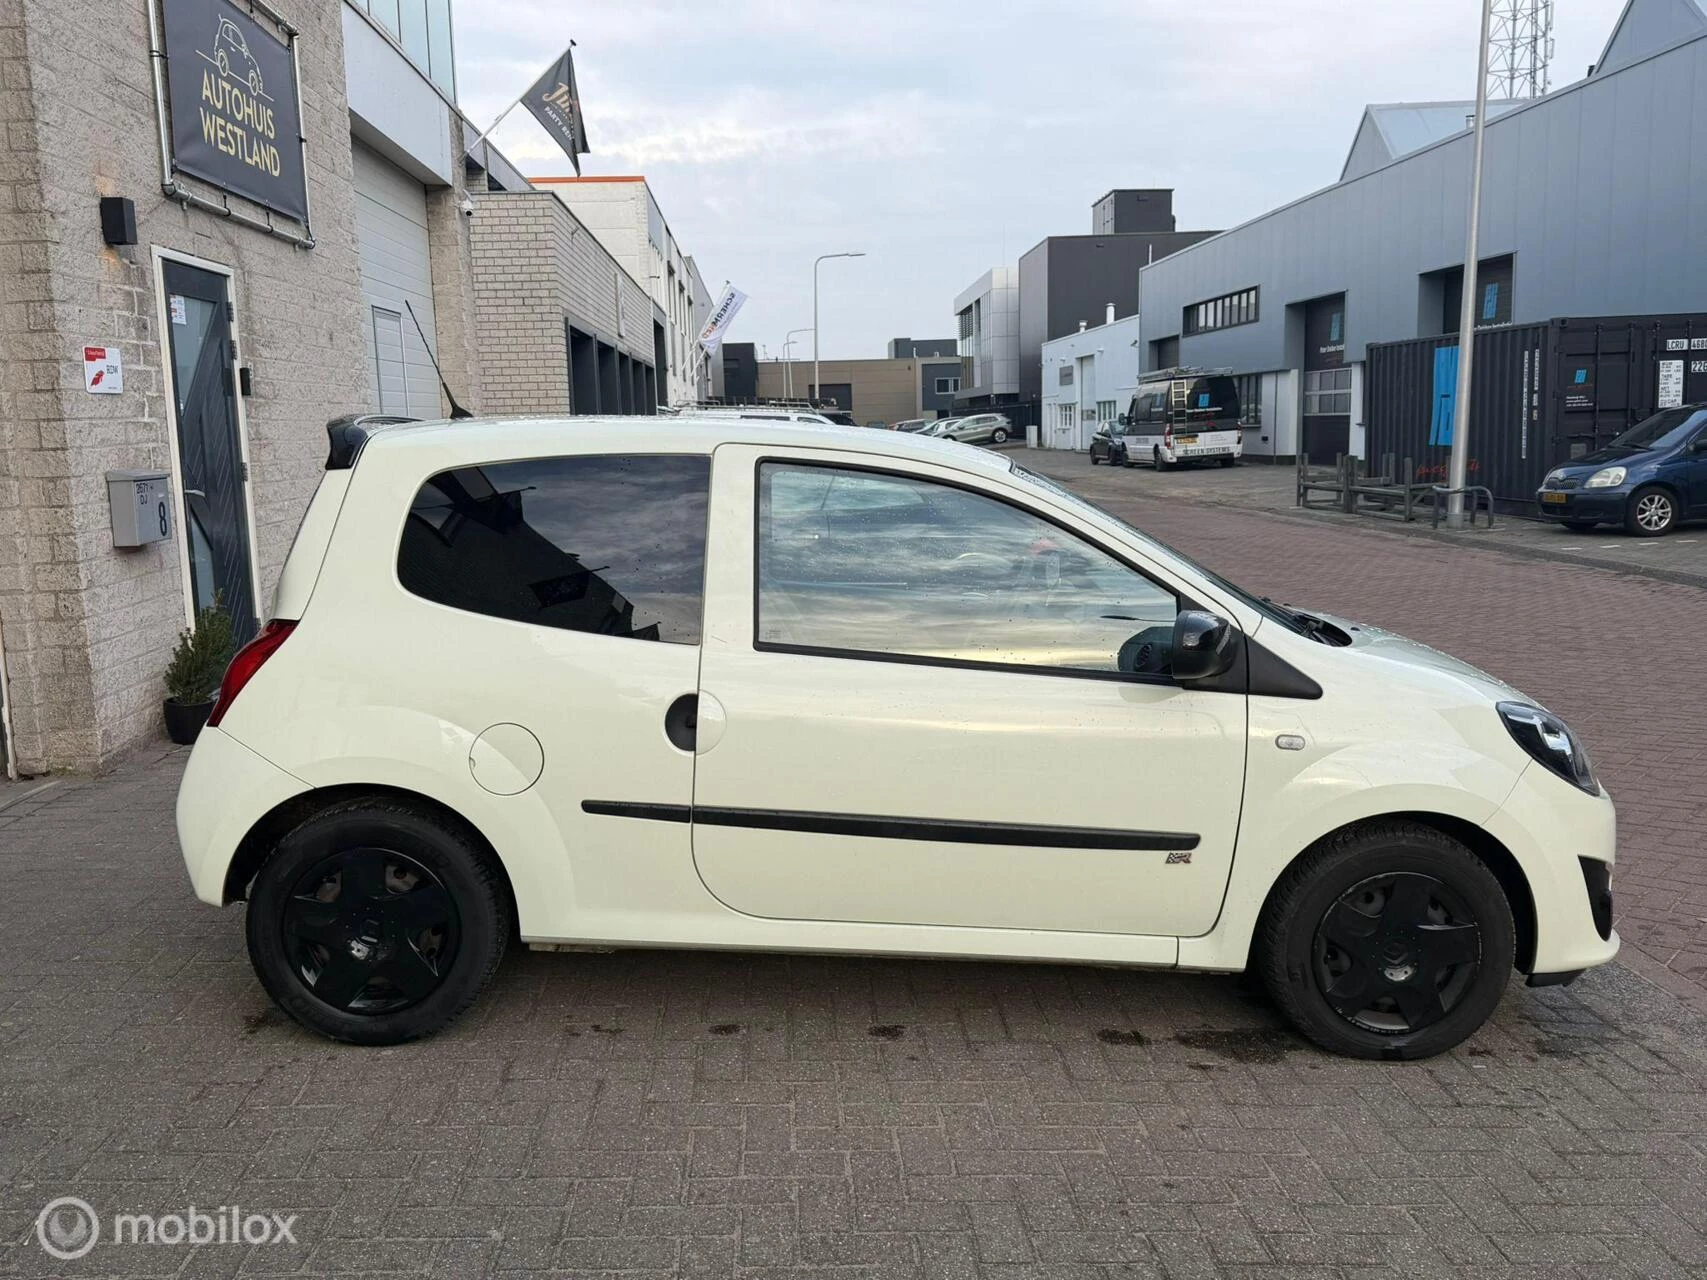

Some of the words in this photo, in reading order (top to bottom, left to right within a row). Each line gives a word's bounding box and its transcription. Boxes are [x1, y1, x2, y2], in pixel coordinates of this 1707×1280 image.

[202, 68, 275, 140] AUTOHUIS
[544, 106, 563, 126] PARTY
[200, 106, 281, 177] WESTLAND
[1667, 340, 1685, 350] LCRU
[1206, 446, 1230, 454] SYSTEMS
[158, 501, 168, 537] 8
